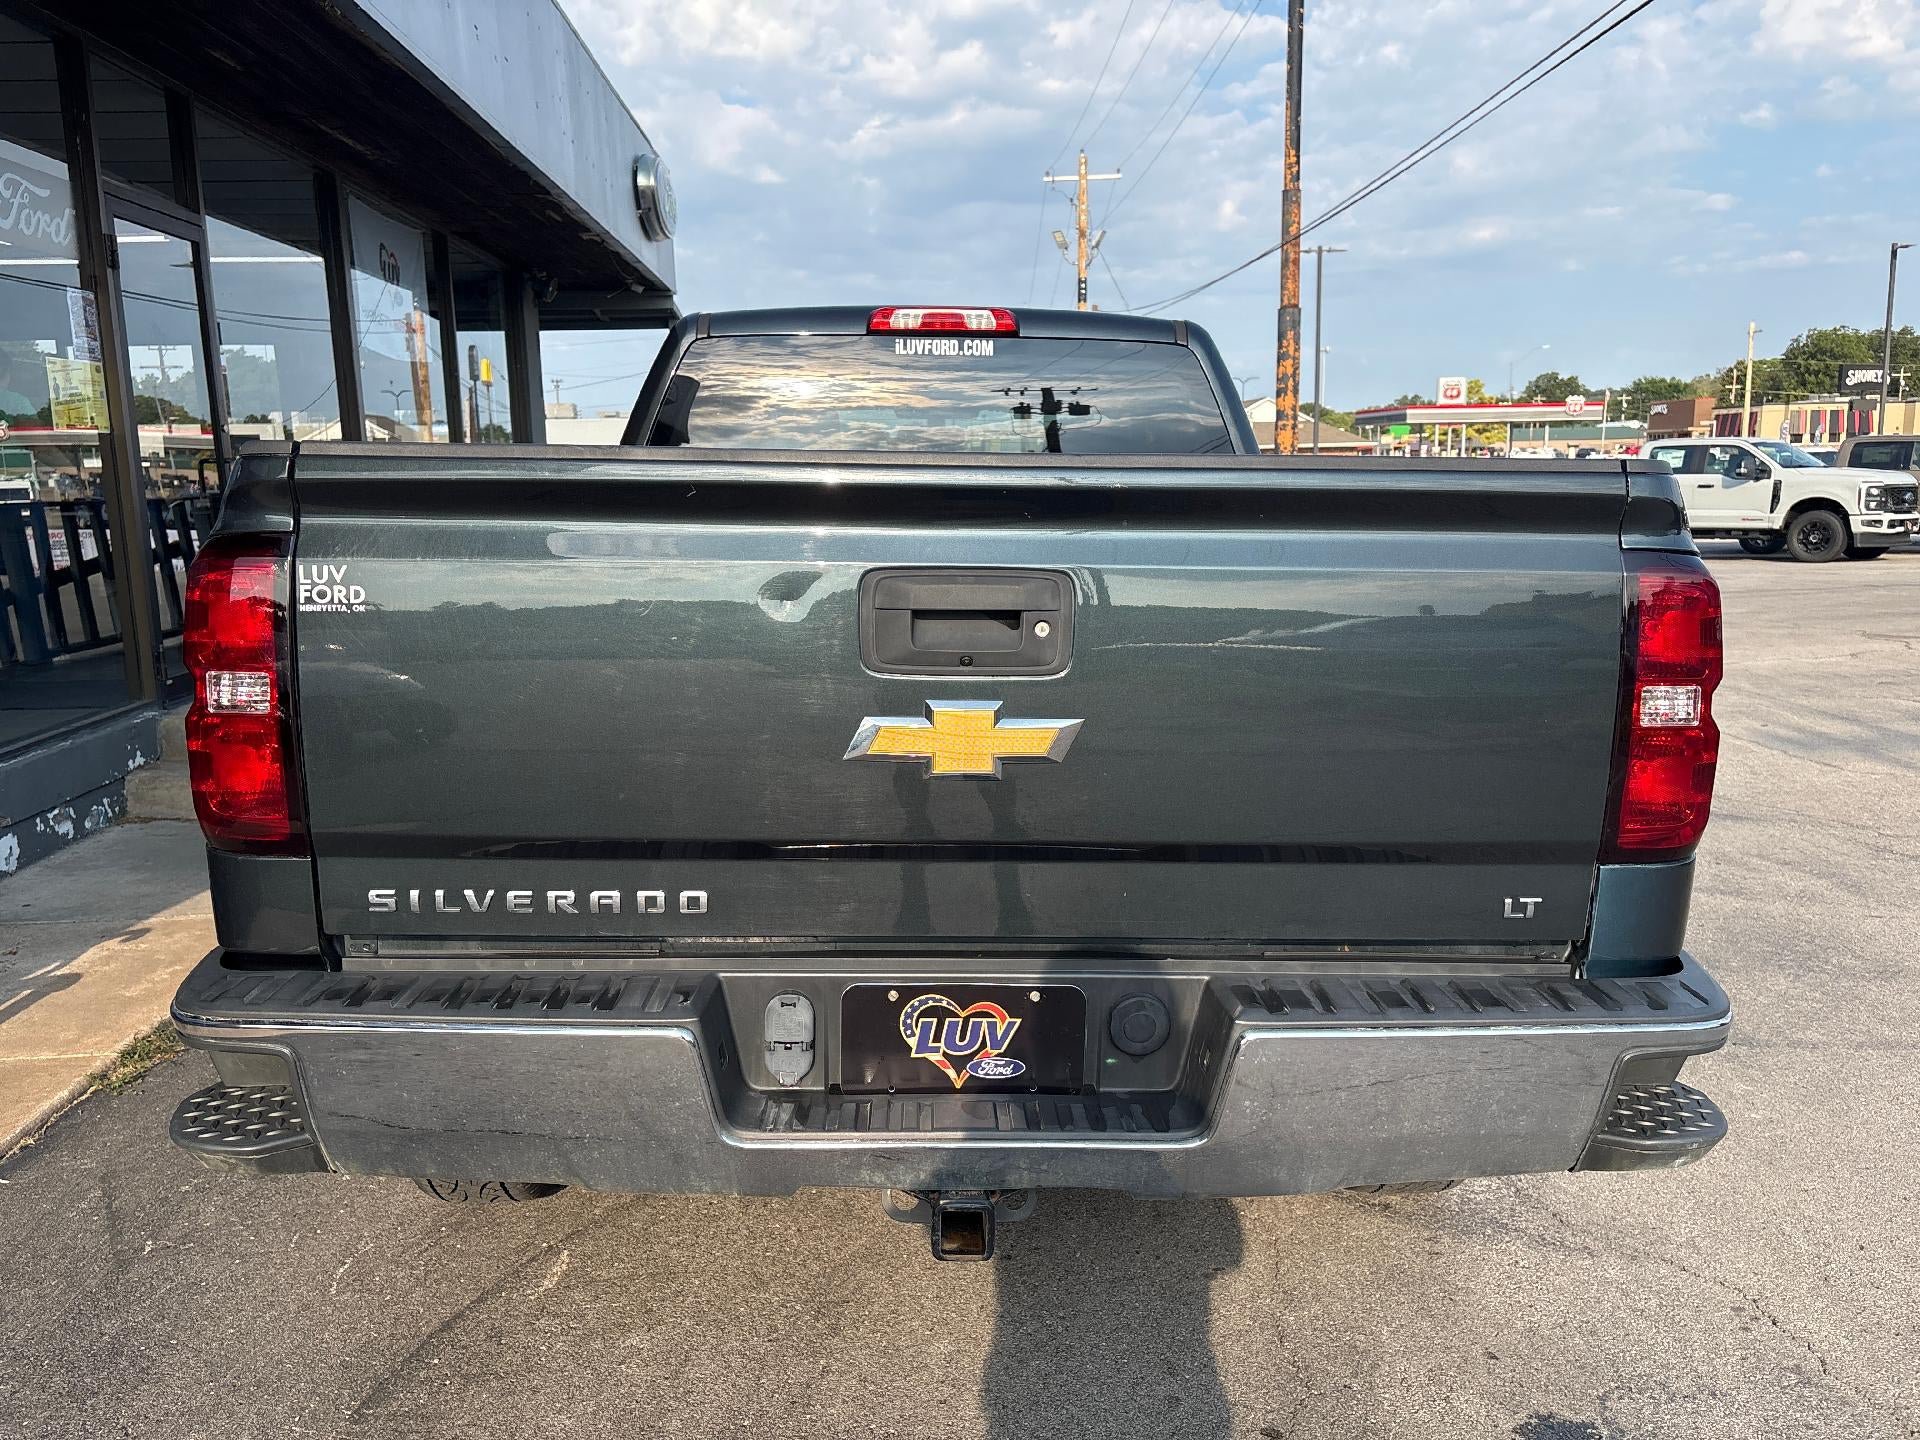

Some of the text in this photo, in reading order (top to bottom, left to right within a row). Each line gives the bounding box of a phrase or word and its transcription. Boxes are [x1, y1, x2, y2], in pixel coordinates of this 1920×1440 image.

[0, 173, 71, 247] Ford
[895, 338, 994, 356] iLUVFORD.COM
[299, 564, 348, 584] LUV
[299, 584, 366, 604] FORD
[299, 604, 366, 614] HENRYETTA, OK
[367, 889, 709, 914] SILVERADO
[1503, 897, 1543, 919] LT
[911, 1017, 1022, 1057] LUV
[977, 1060, 1015, 1075] Ford
